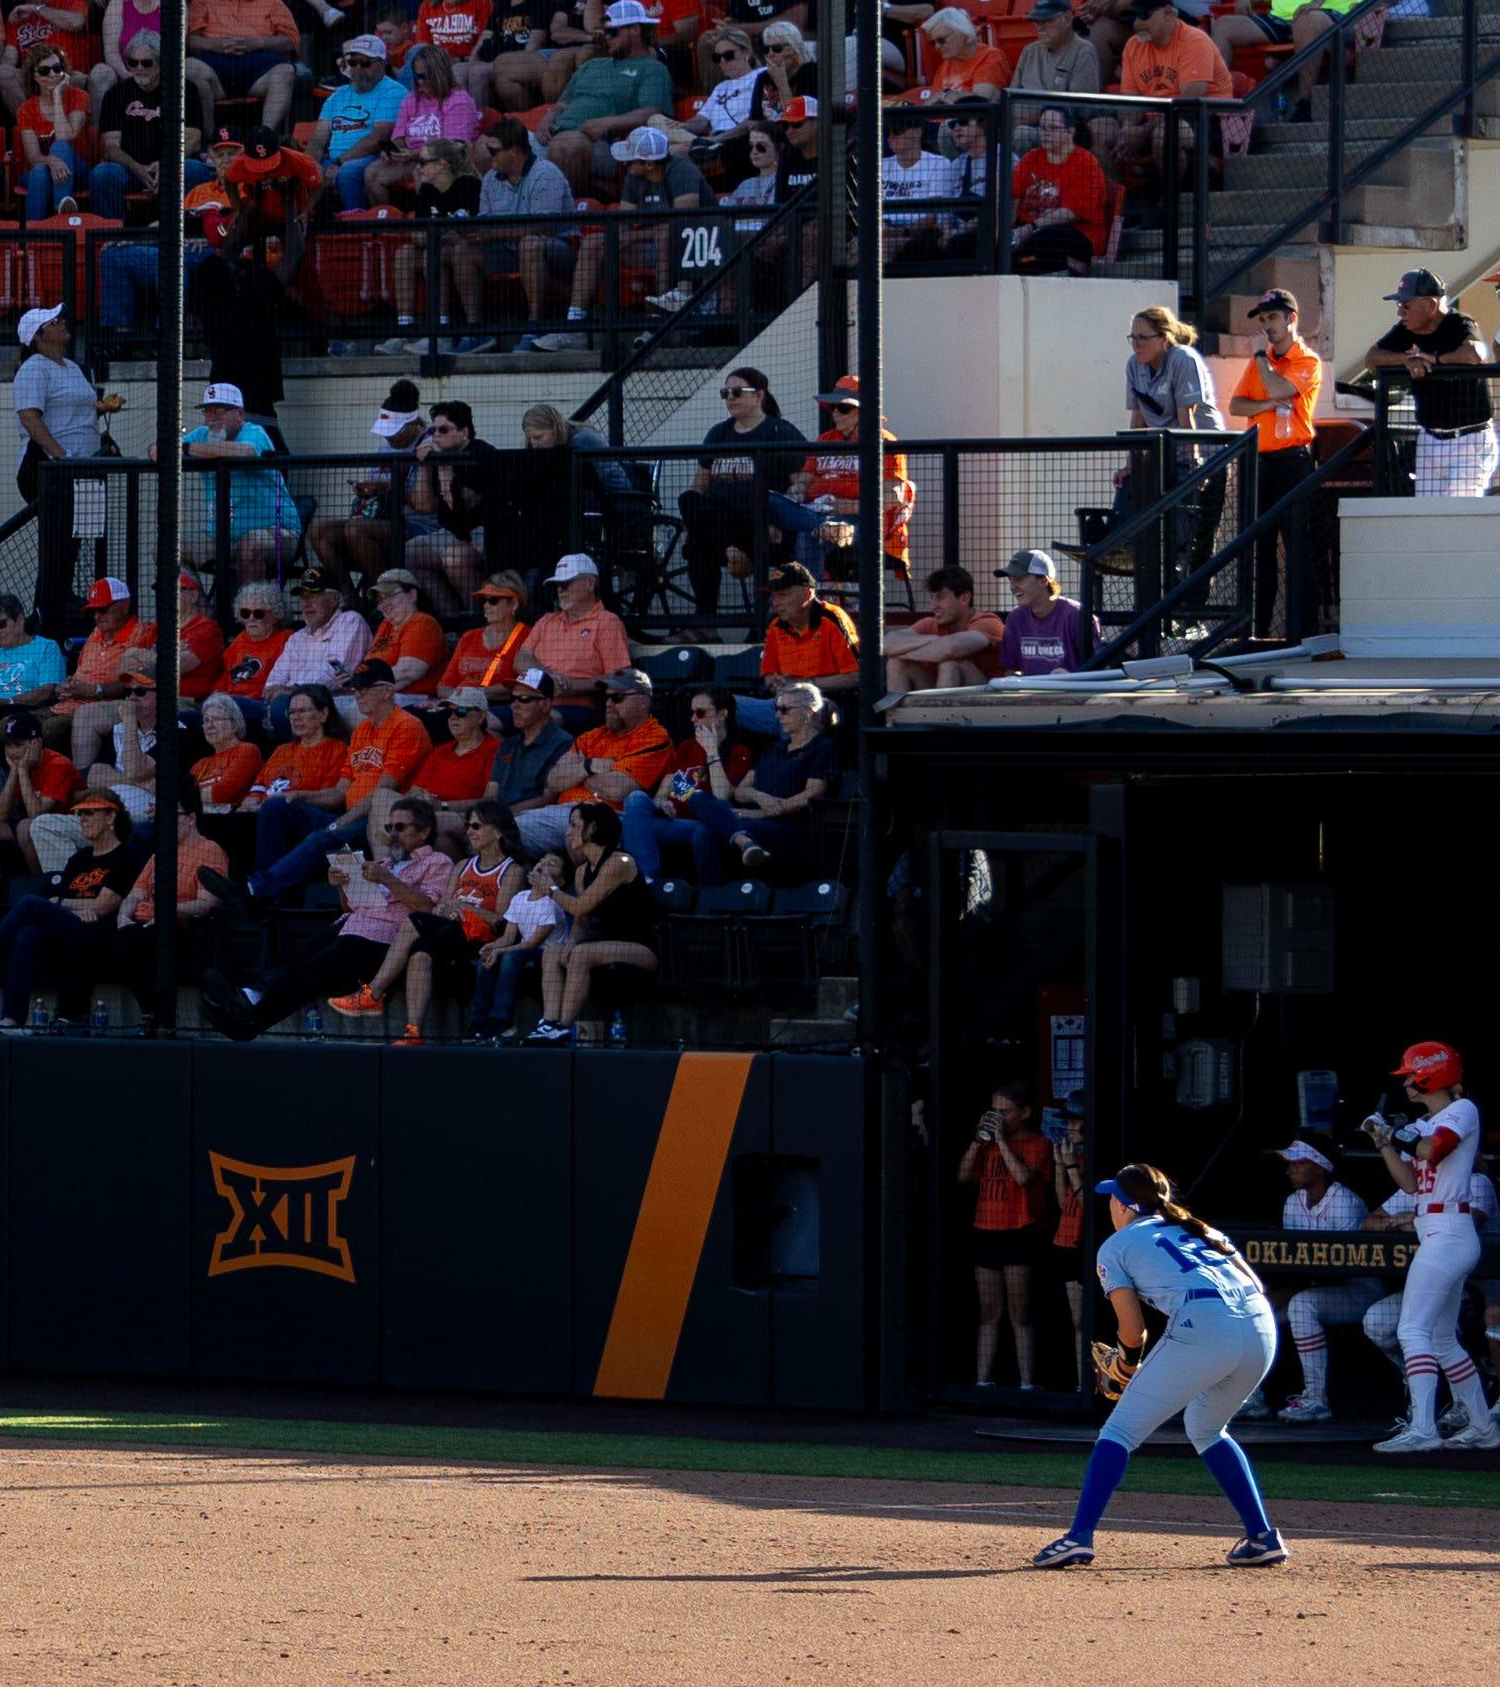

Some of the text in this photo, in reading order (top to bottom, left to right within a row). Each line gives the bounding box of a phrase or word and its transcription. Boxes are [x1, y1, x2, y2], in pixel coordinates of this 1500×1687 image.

[681, 226, 722, 269] 204
[214, 1164, 351, 1269] XII
[1246, 1241, 1387, 1268] OKLAHOMA
